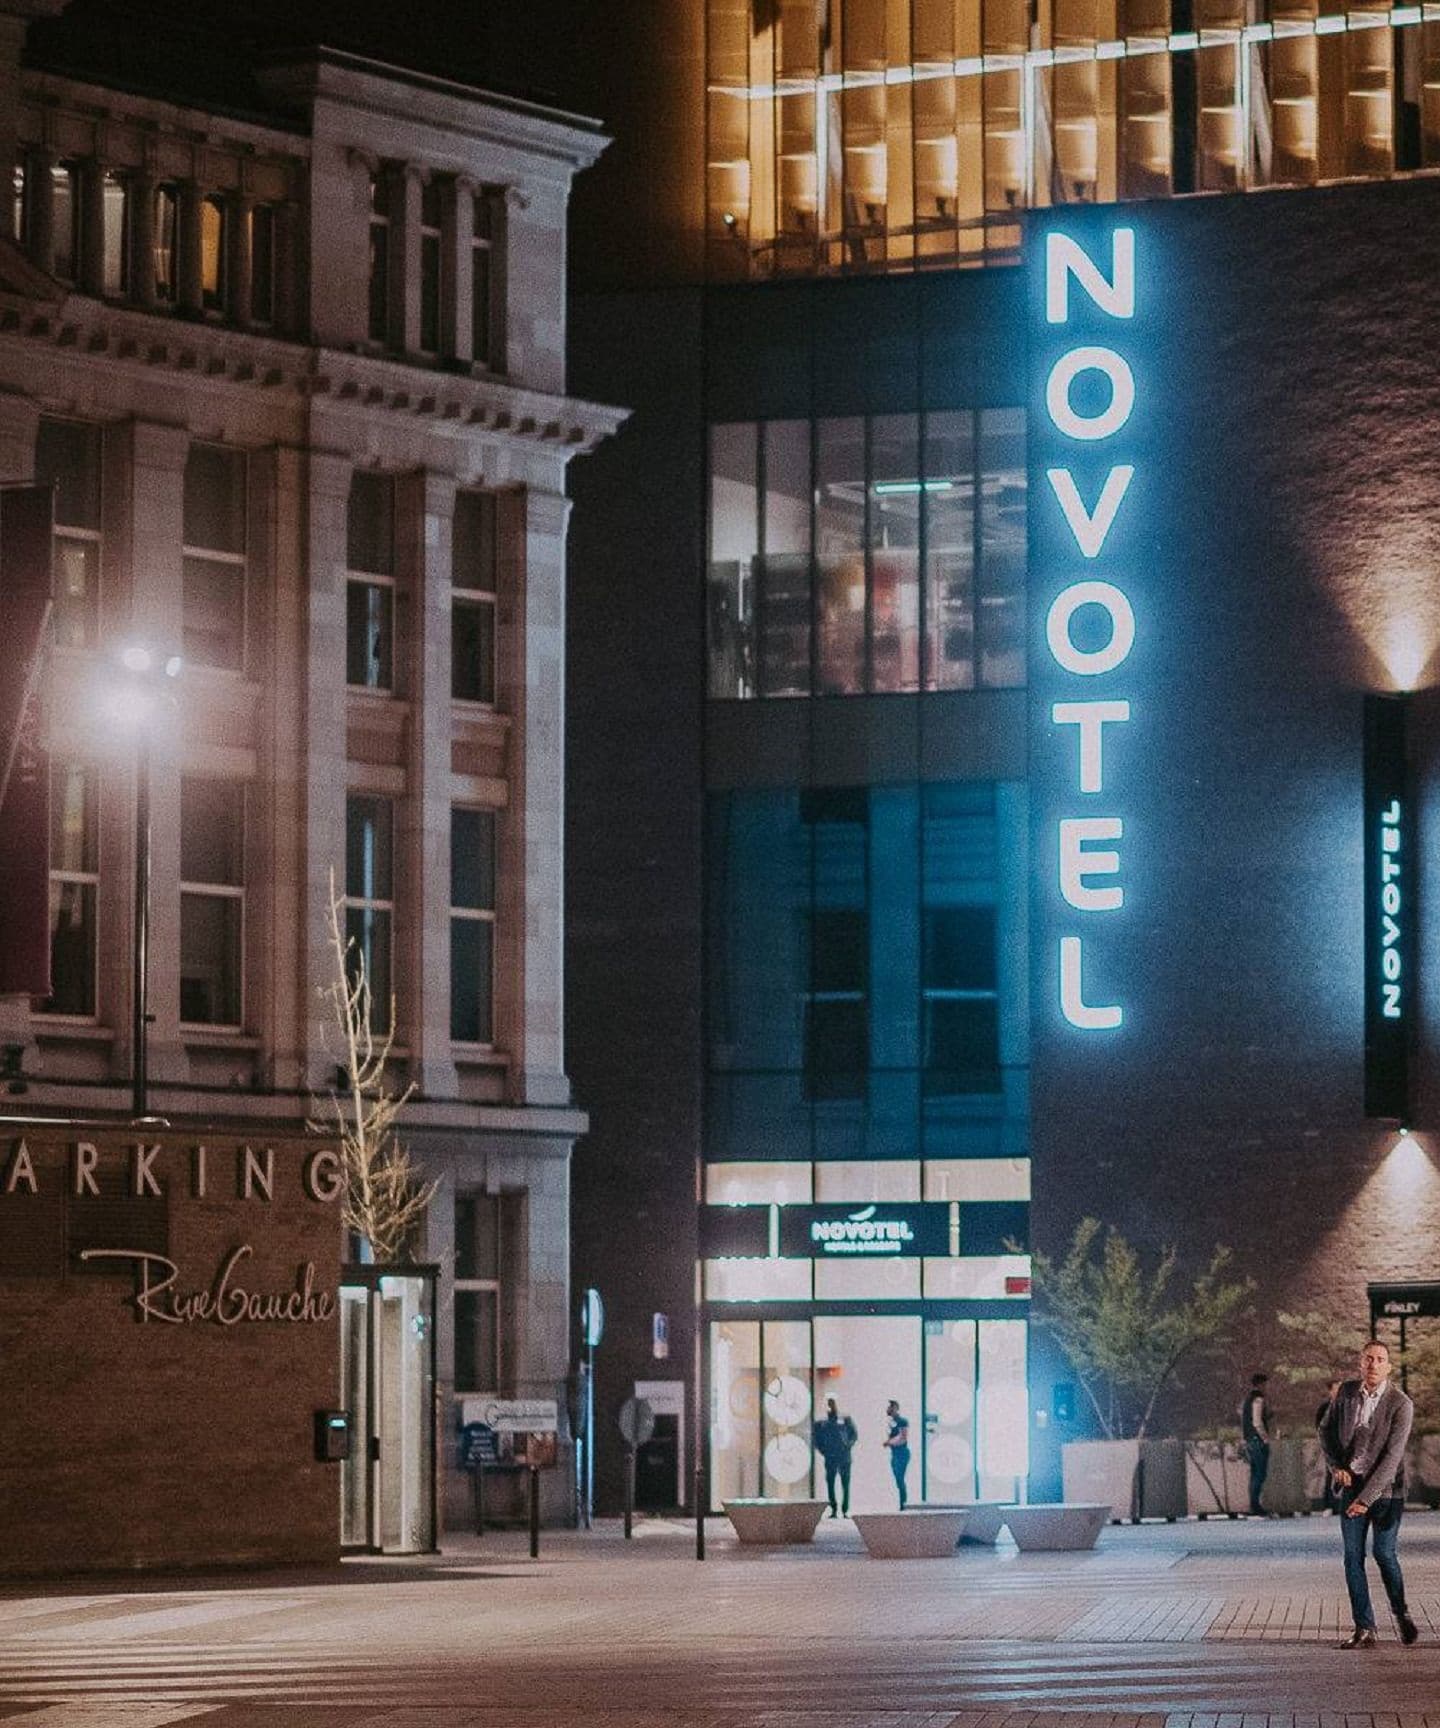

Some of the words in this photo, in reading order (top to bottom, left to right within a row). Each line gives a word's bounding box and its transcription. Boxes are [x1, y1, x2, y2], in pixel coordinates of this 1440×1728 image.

[1045, 227, 1136, 1030] NOVOTEL
[1381, 800, 1401, 1018] NOVOTEL
[811, 1220, 914, 1241] NOVOTEL
